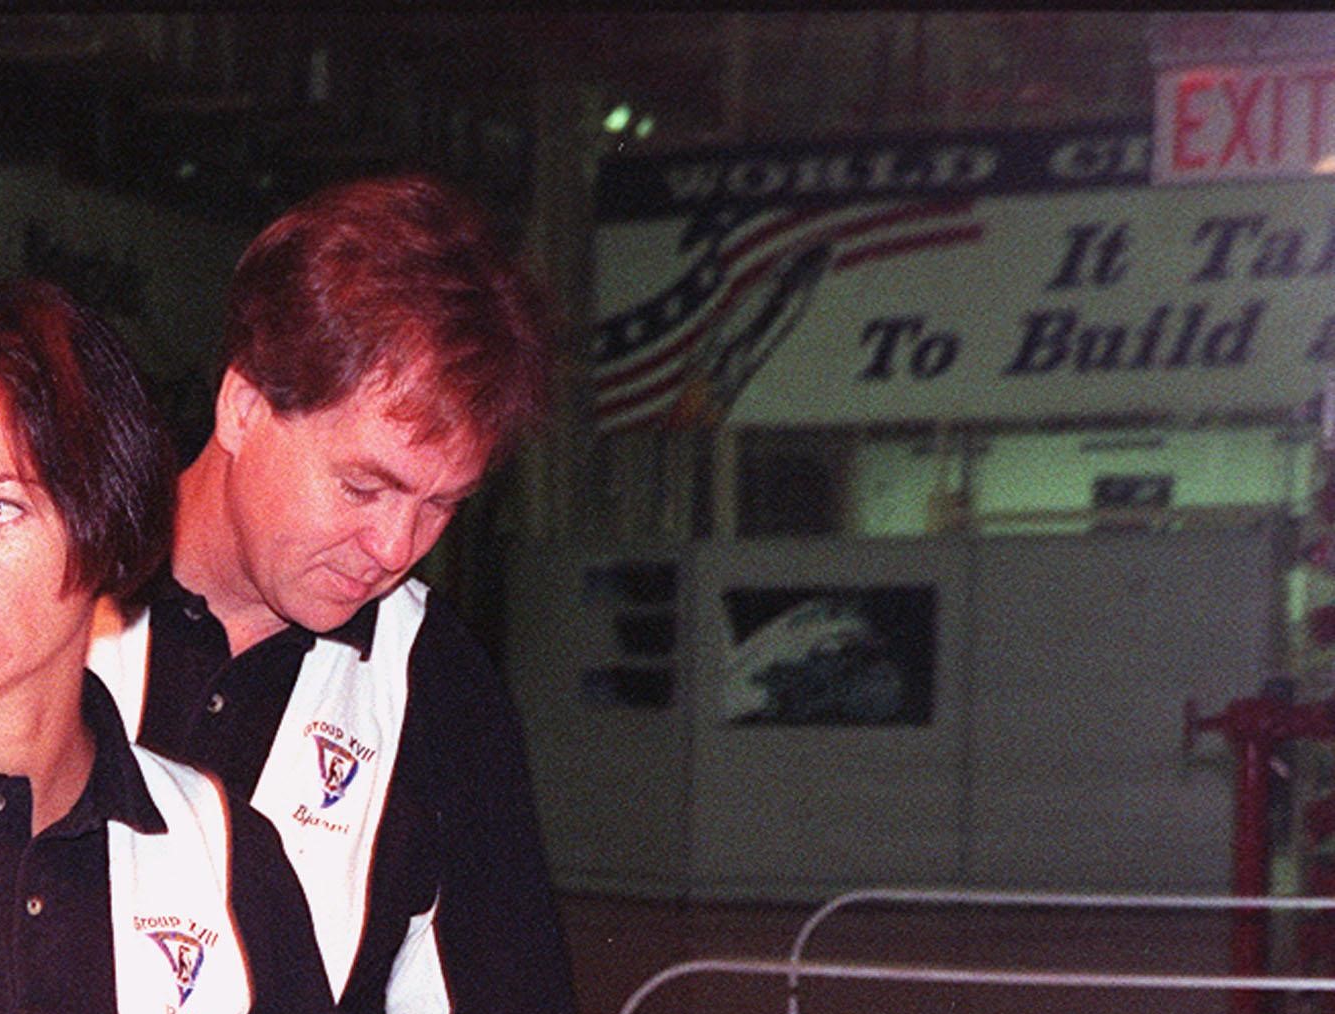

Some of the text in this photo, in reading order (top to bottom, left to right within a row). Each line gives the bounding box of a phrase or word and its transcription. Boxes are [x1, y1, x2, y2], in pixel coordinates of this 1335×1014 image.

[1171, 70, 1335, 170] EXIT
[663, 143, 999, 200] WORLD
[1043, 219, 1131, 292] It
[858, 314, 963, 382] To
[1000, 300, 1269, 377] Build
[303, 721, 344, 740] Group
[133, 916, 181, 931] Group
